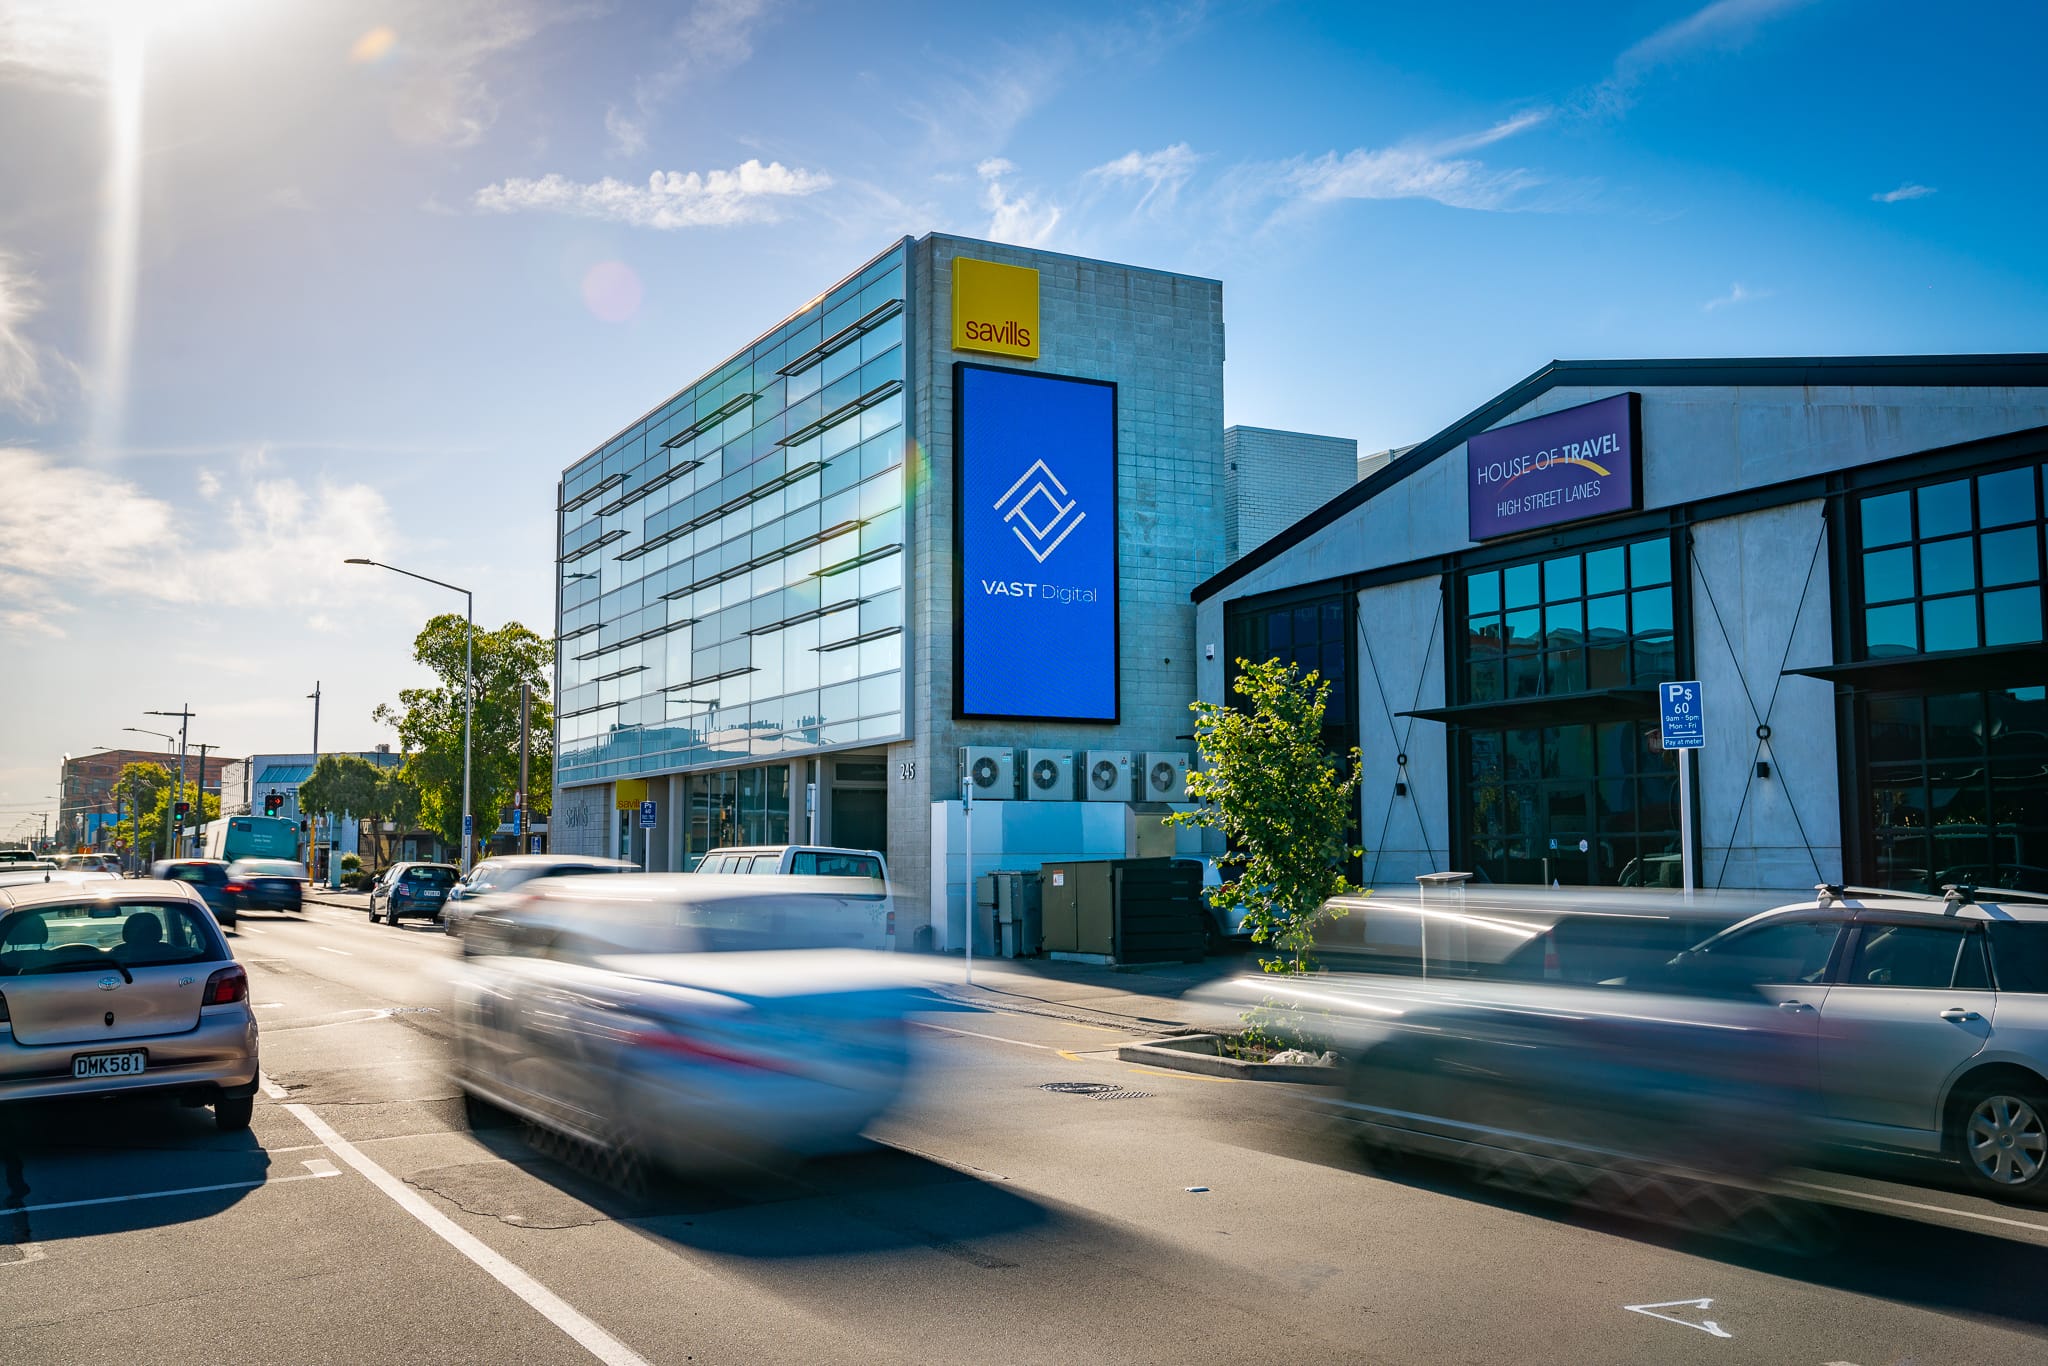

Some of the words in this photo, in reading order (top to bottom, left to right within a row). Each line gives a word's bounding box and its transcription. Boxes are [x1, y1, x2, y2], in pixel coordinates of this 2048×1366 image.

[966, 320, 1031, 347] savills
[1477, 455, 1531, 485] HOUSE
[1535, 448, 1558, 471] OF
[1562, 433, 1620, 464] TRAVEL
[1497, 499, 1521, 518] HIGH
[1524, 488, 1563, 512] STREET
[1565, 480, 1601, 503] LANES
[981, 579, 1037, 598] VAST
[1042, 584, 1097, 605] Digital
[1674, 703, 1689, 713] 60
[900, 763, 915, 780] 245
[617, 799, 641, 809] savill
[77, 1056, 141, 1075] DMK581
